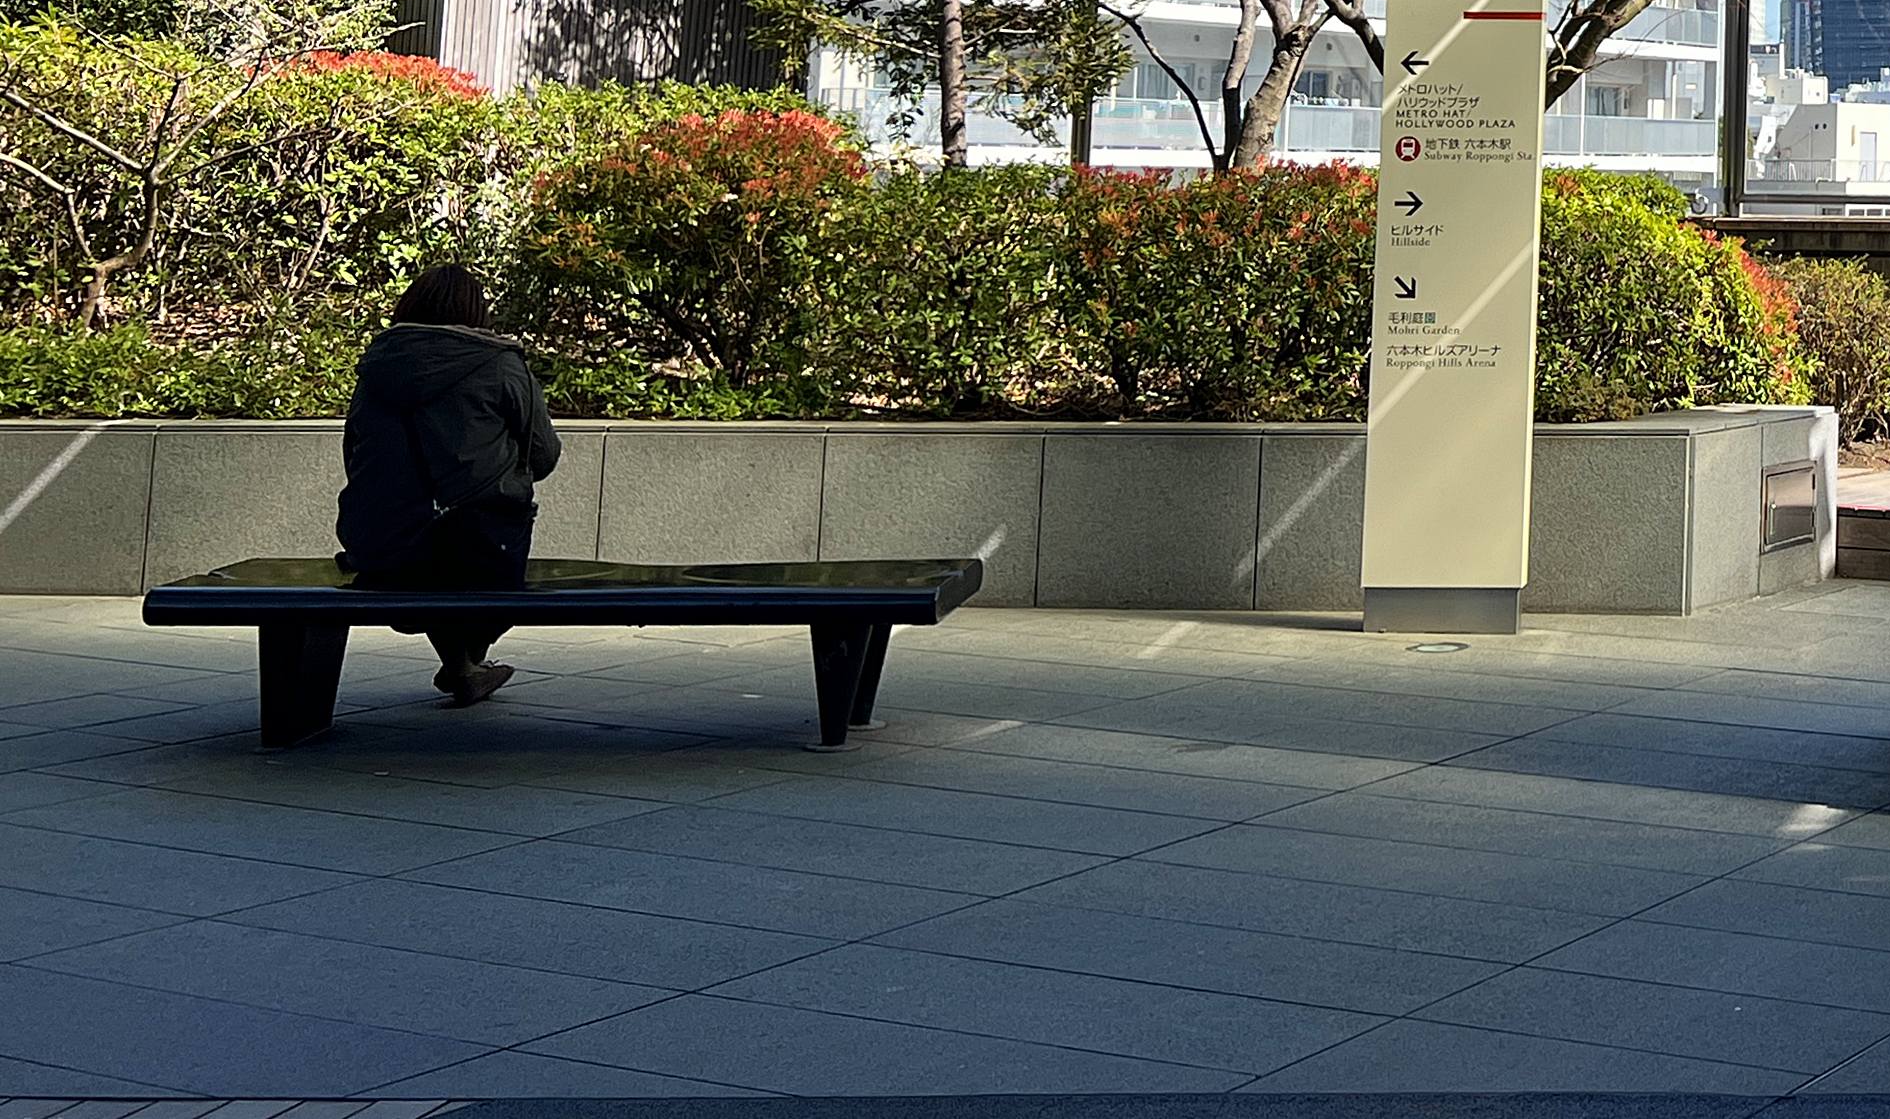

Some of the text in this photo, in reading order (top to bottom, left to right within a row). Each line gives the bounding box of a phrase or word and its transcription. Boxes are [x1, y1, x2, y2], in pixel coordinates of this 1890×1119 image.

[1397, 96, 1480, 109] ハリウッドプラザ
[1396, 109, 1472, 118] METRO HAT/
[1395, 119, 1516, 129] HOLLYWOOD PLAZA
[1425, 138, 1512, 150] 地下鉄 六本木駅
[1424, 151, 1462, 162] Subway
[1466, 151, 1515, 164] Roppongi
[1391, 225, 1444, 236] ヒルサイド
[1391, 237, 1431, 247] Hillside
[1388, 312, 1436, 324] 毛利庭園
[1387, 325, 1460, 335] Mohri Garden
[1386, 344, 1501, 357] 六本木ヒルズアリーナ
[1386, 358, 1496, 369] Roppongi Hills Arena
